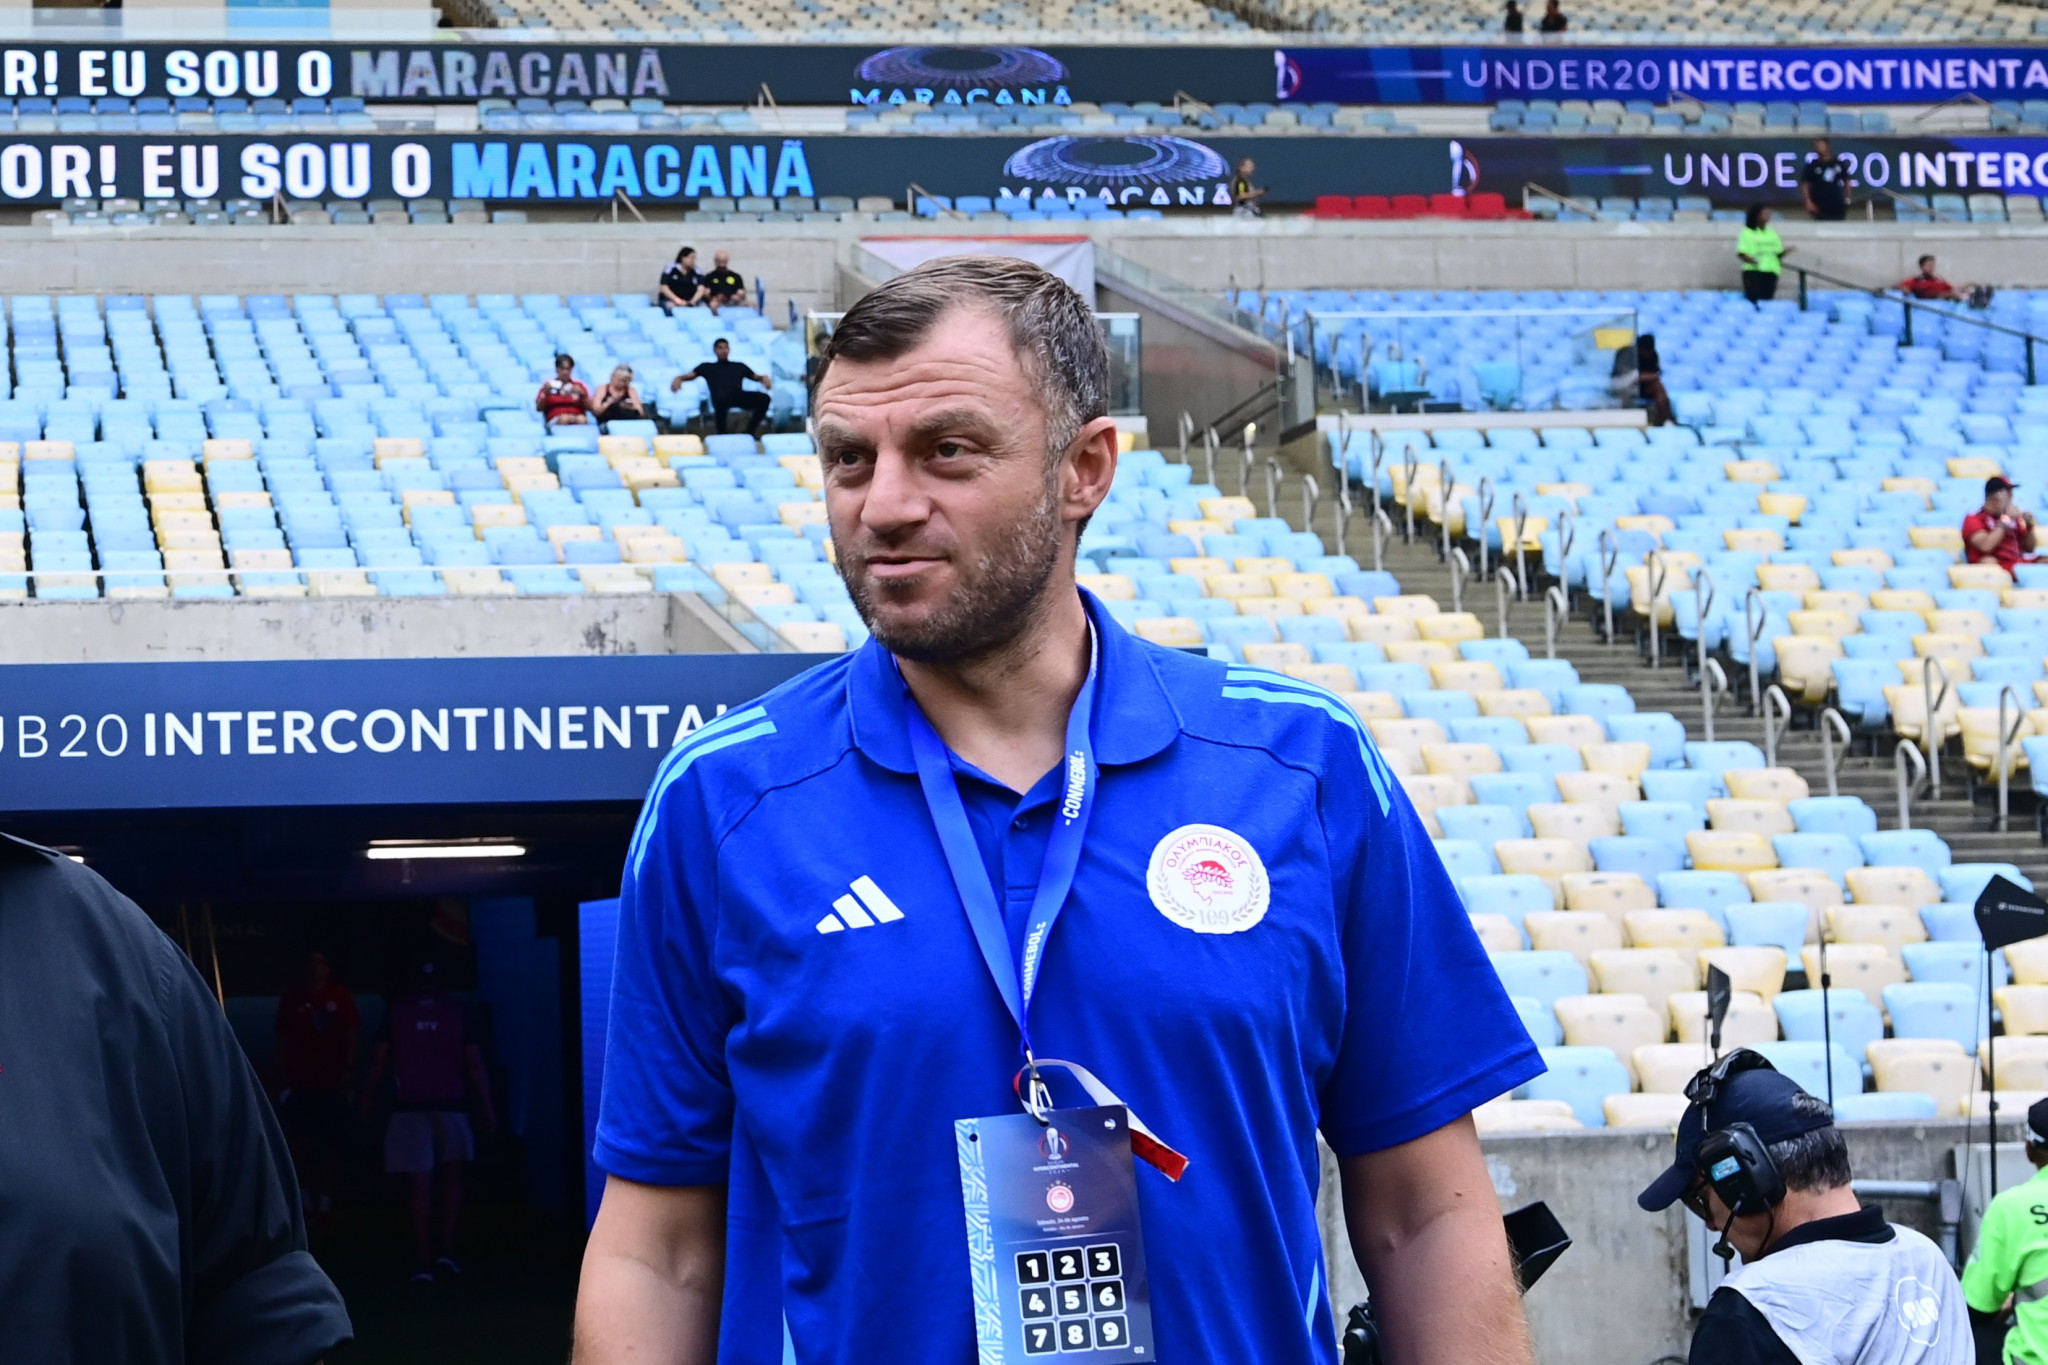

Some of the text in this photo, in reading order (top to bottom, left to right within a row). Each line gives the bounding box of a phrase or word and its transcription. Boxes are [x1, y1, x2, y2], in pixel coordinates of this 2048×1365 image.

[79, 50, 147, 97] EU
[165, 50, 279, 97] SOU
[298, 50, 332, 97] O
[351, 48, 670, 97] MARACANÃ
[1464, 60, 1660, 90] UNDER20
[143, 144, 220, 198] EU
[241, 144, 371, 198] SOU
[392, 144, 431, 198] O
[452, 140, 814, 198] MARACANÃ
[0, 713, 128, 758] B20
[1062, 754, 1086, 820] CONMEBOL
[1024, 928, 1044, 1001] CONMEBOL
[1026, 1252, 1112, 1278] 1 2 3
[1029, 1286, 1116, 1312] 4 5 6
[1032, 1321, 1120, 1349] 7 8 9
